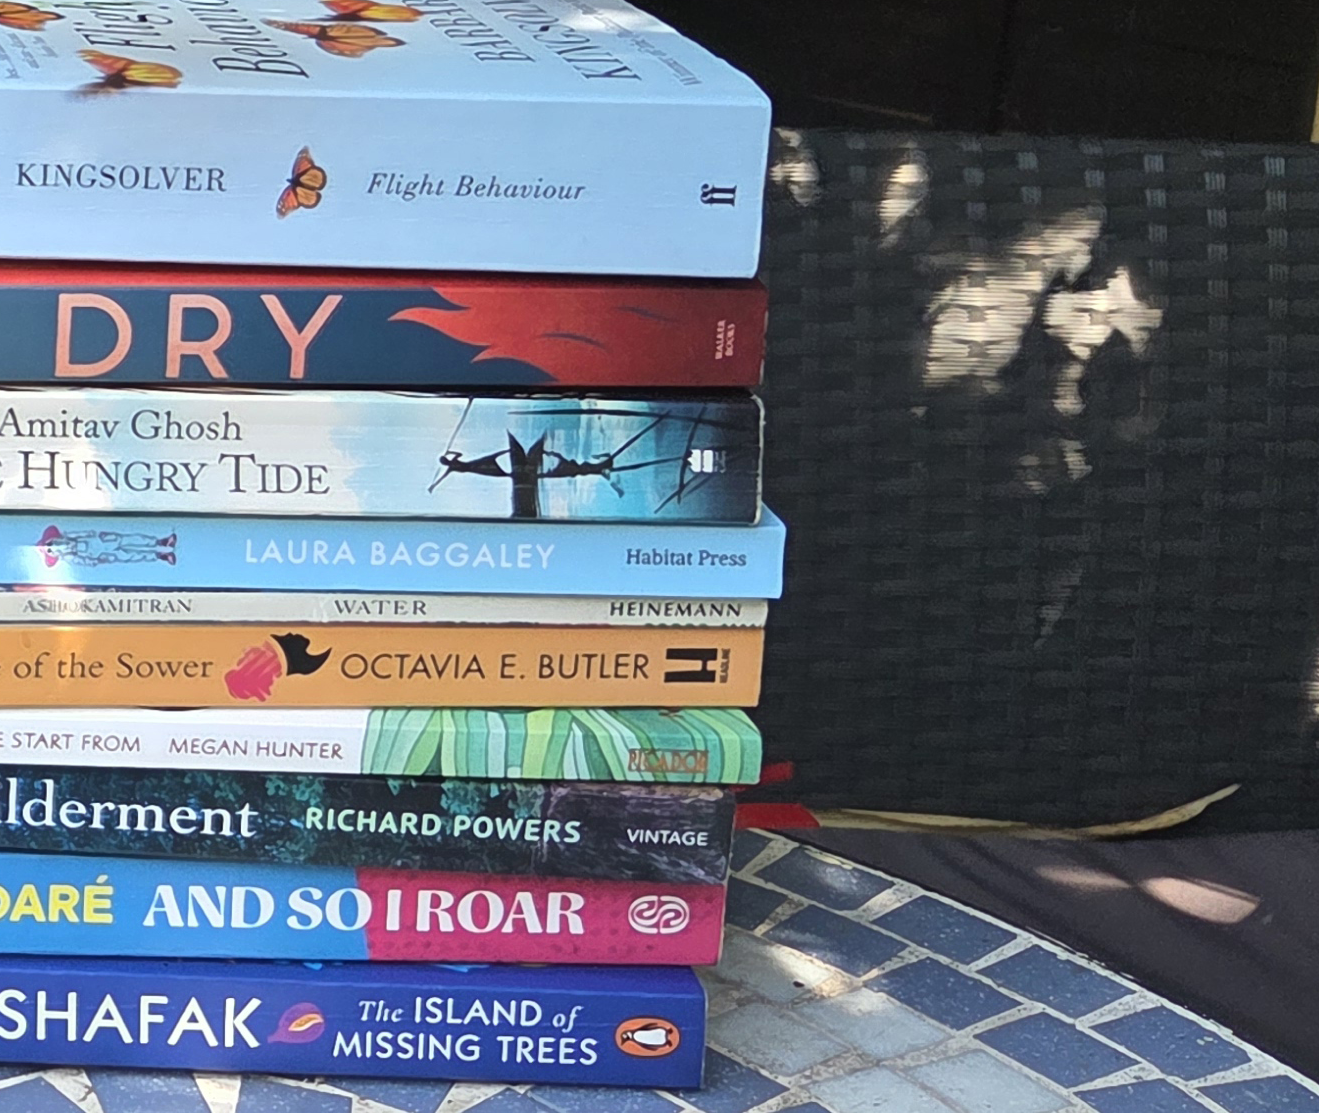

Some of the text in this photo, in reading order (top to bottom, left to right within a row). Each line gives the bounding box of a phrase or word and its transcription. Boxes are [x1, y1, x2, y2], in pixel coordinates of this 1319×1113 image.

[16, 163, 227, 192] KINGSOLVER
[366, 172, 586, 202] Flight Behaviour
[54, 293, 344, 380] DRY
[130, 408, 243, 442] Ghosh
[17, 449, 207, 493] HUNGRY
[218, 452, 331, 495] TIDE
[244, 539, 555, 570] LAURA BAGGALEY
[625, 547, 747, 569] Habitat Press
[23, 598, 192, 613] ASHOKAMITRAN
[333, 599, 428, 616] WATER
[608, 600, 742, 618] HEINEMANN
[13, 651, 51, 680] of
[57, 653, 104, 679] the
[116, 652, 214, 679] Sower
[340, 653, 650, 680] OCTAVIA E. BUTLER
[11, 731, 75, 751] START
[80, 734, 141, 753] FROM
[168, 737, 344, 761] MEGAN HUNTER
[628, 749, 709, 773] PICADOR
[305, 806, 582, 844] RICHARD POWERS
[626, 828, 708, 847] VINTAGE
[142, 885, 585, 935] AND SO I ROAR
[359, 996, 584, 1032] The ISLAND of
[332, 1031, 598, 1065] MISSING TREES
